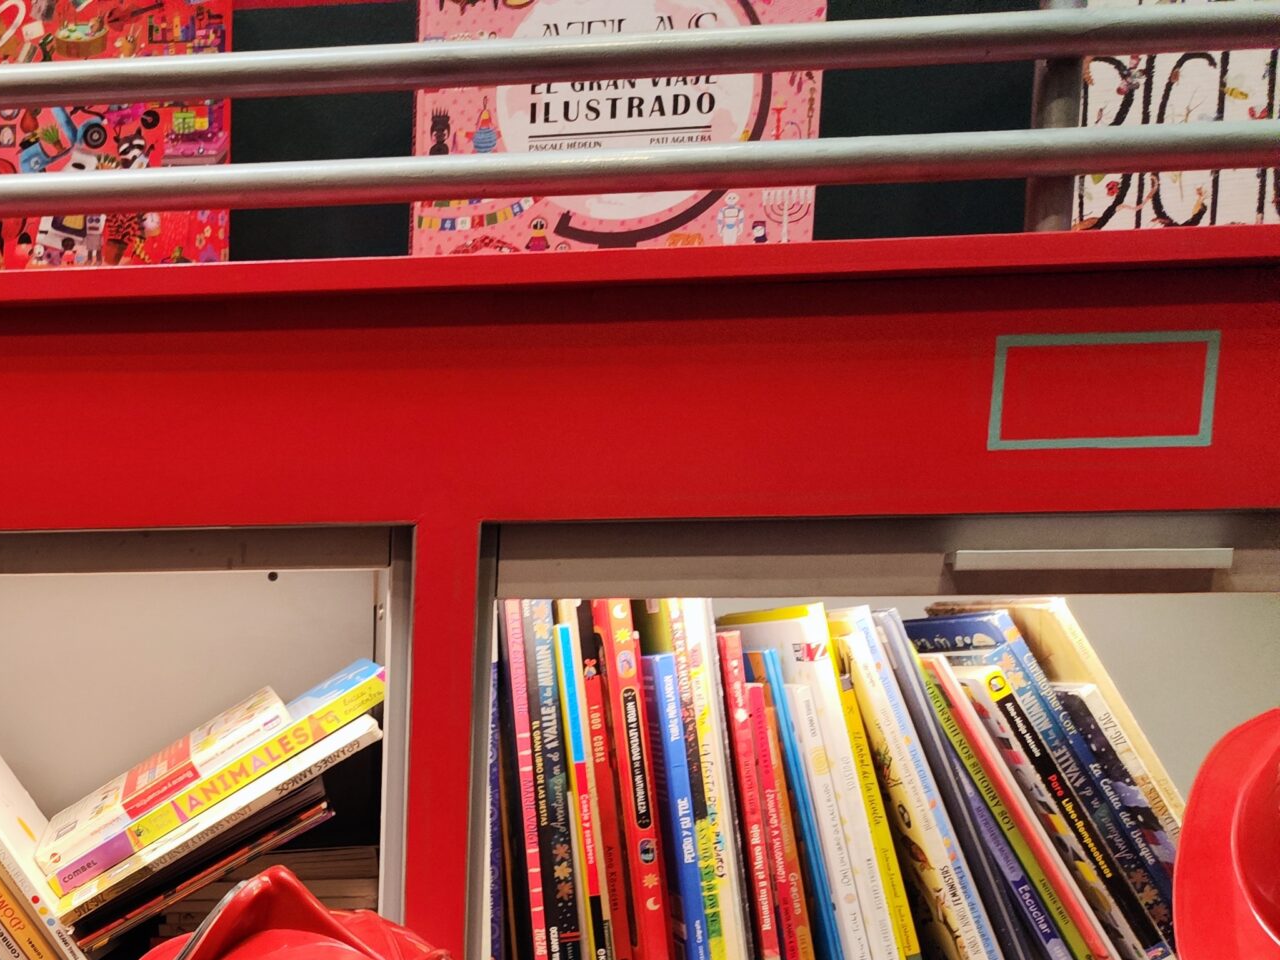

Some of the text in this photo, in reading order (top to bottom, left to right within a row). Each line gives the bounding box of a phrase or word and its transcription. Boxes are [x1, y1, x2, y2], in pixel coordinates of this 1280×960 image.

[530, 92, 715, 124] ILUSTRADO
[528, 143, 563, 152] PASCALE
[592, 734, 606, 763] COSAS
[955, 737, 974, 761] SON
[180, 723, 312, 813] ANIMALES
[531, 719, 548, 826] EL GRAN LIBRO DE LAS SIESTAS
[938, 864, 962, 908] FEMINISTAS
[1017, 883, 1053, 936] Escuchar
